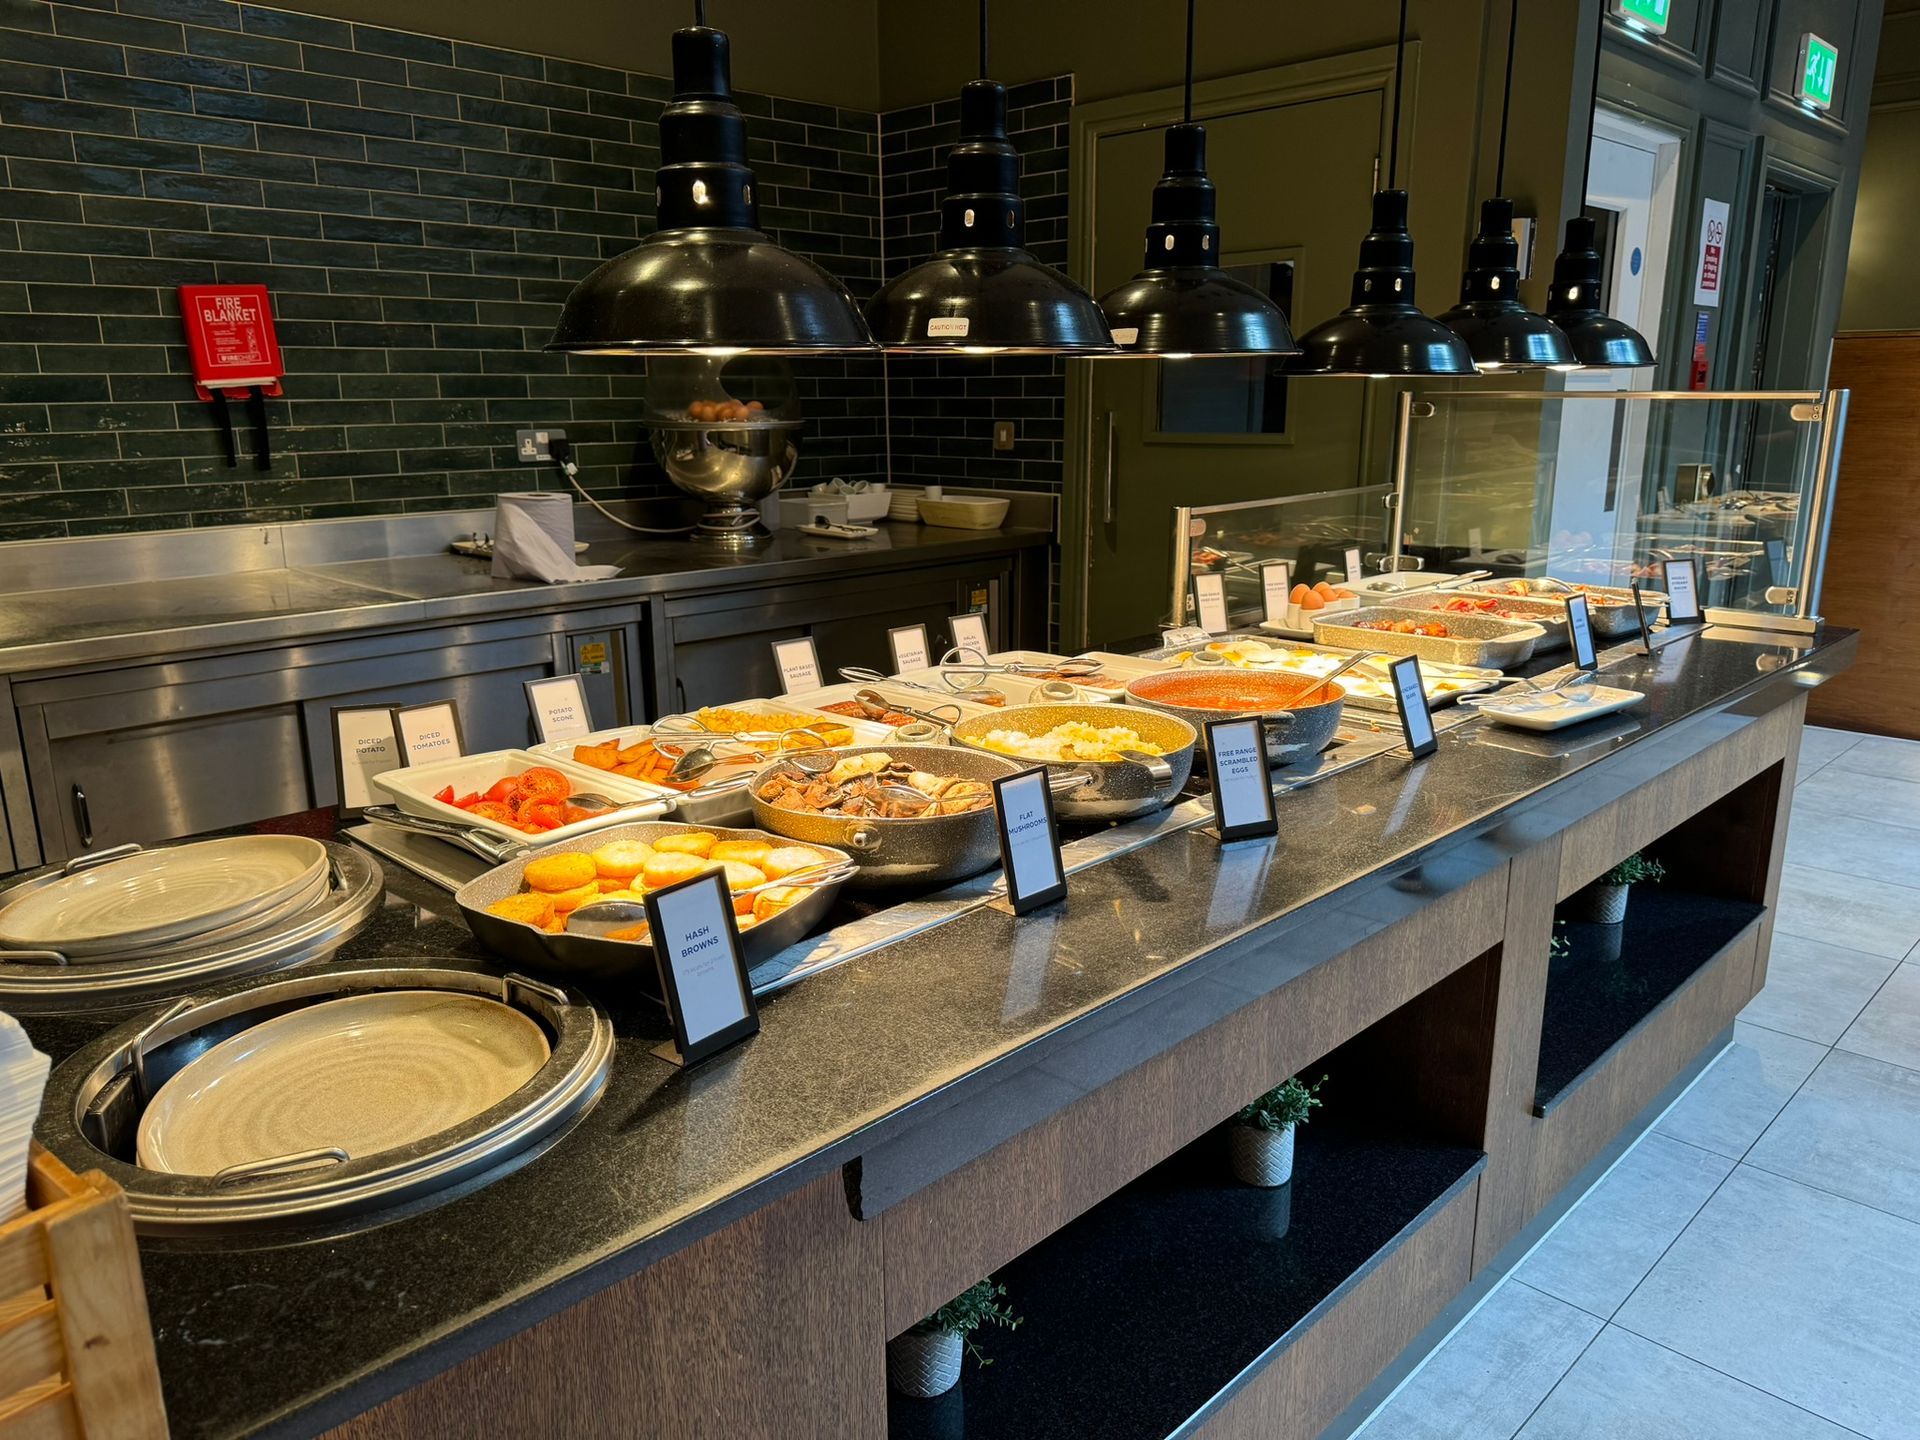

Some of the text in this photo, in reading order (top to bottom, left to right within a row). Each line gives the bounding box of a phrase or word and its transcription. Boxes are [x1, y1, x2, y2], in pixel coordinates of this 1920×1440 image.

[215, 297, 241, 310] FIRE
[203, 309, 256, 322] BLANKET
[548, 706, 573, 716] POTATO
[551, 714, 574, 723] SCONE
[358, 737, 382, 745] DICED
[419, 731, 441, 741] DICED
[355, 745, 386, 754] POTATO
[412, 738, 451, 751] TOMATOES
[1218, 746, 1257, 758] FREE RANGE
[1219, 756, 1258, 767] SCRAMBLED
[1231, 766, 1249, 775] EGGS
[1019, 811, 1034, 822] FLAT
[1008, 816, 1048, 836] MUSHROOMS
[685, 926, 710, 941] HASH
[681, 936, 719, 957] BROWNS
